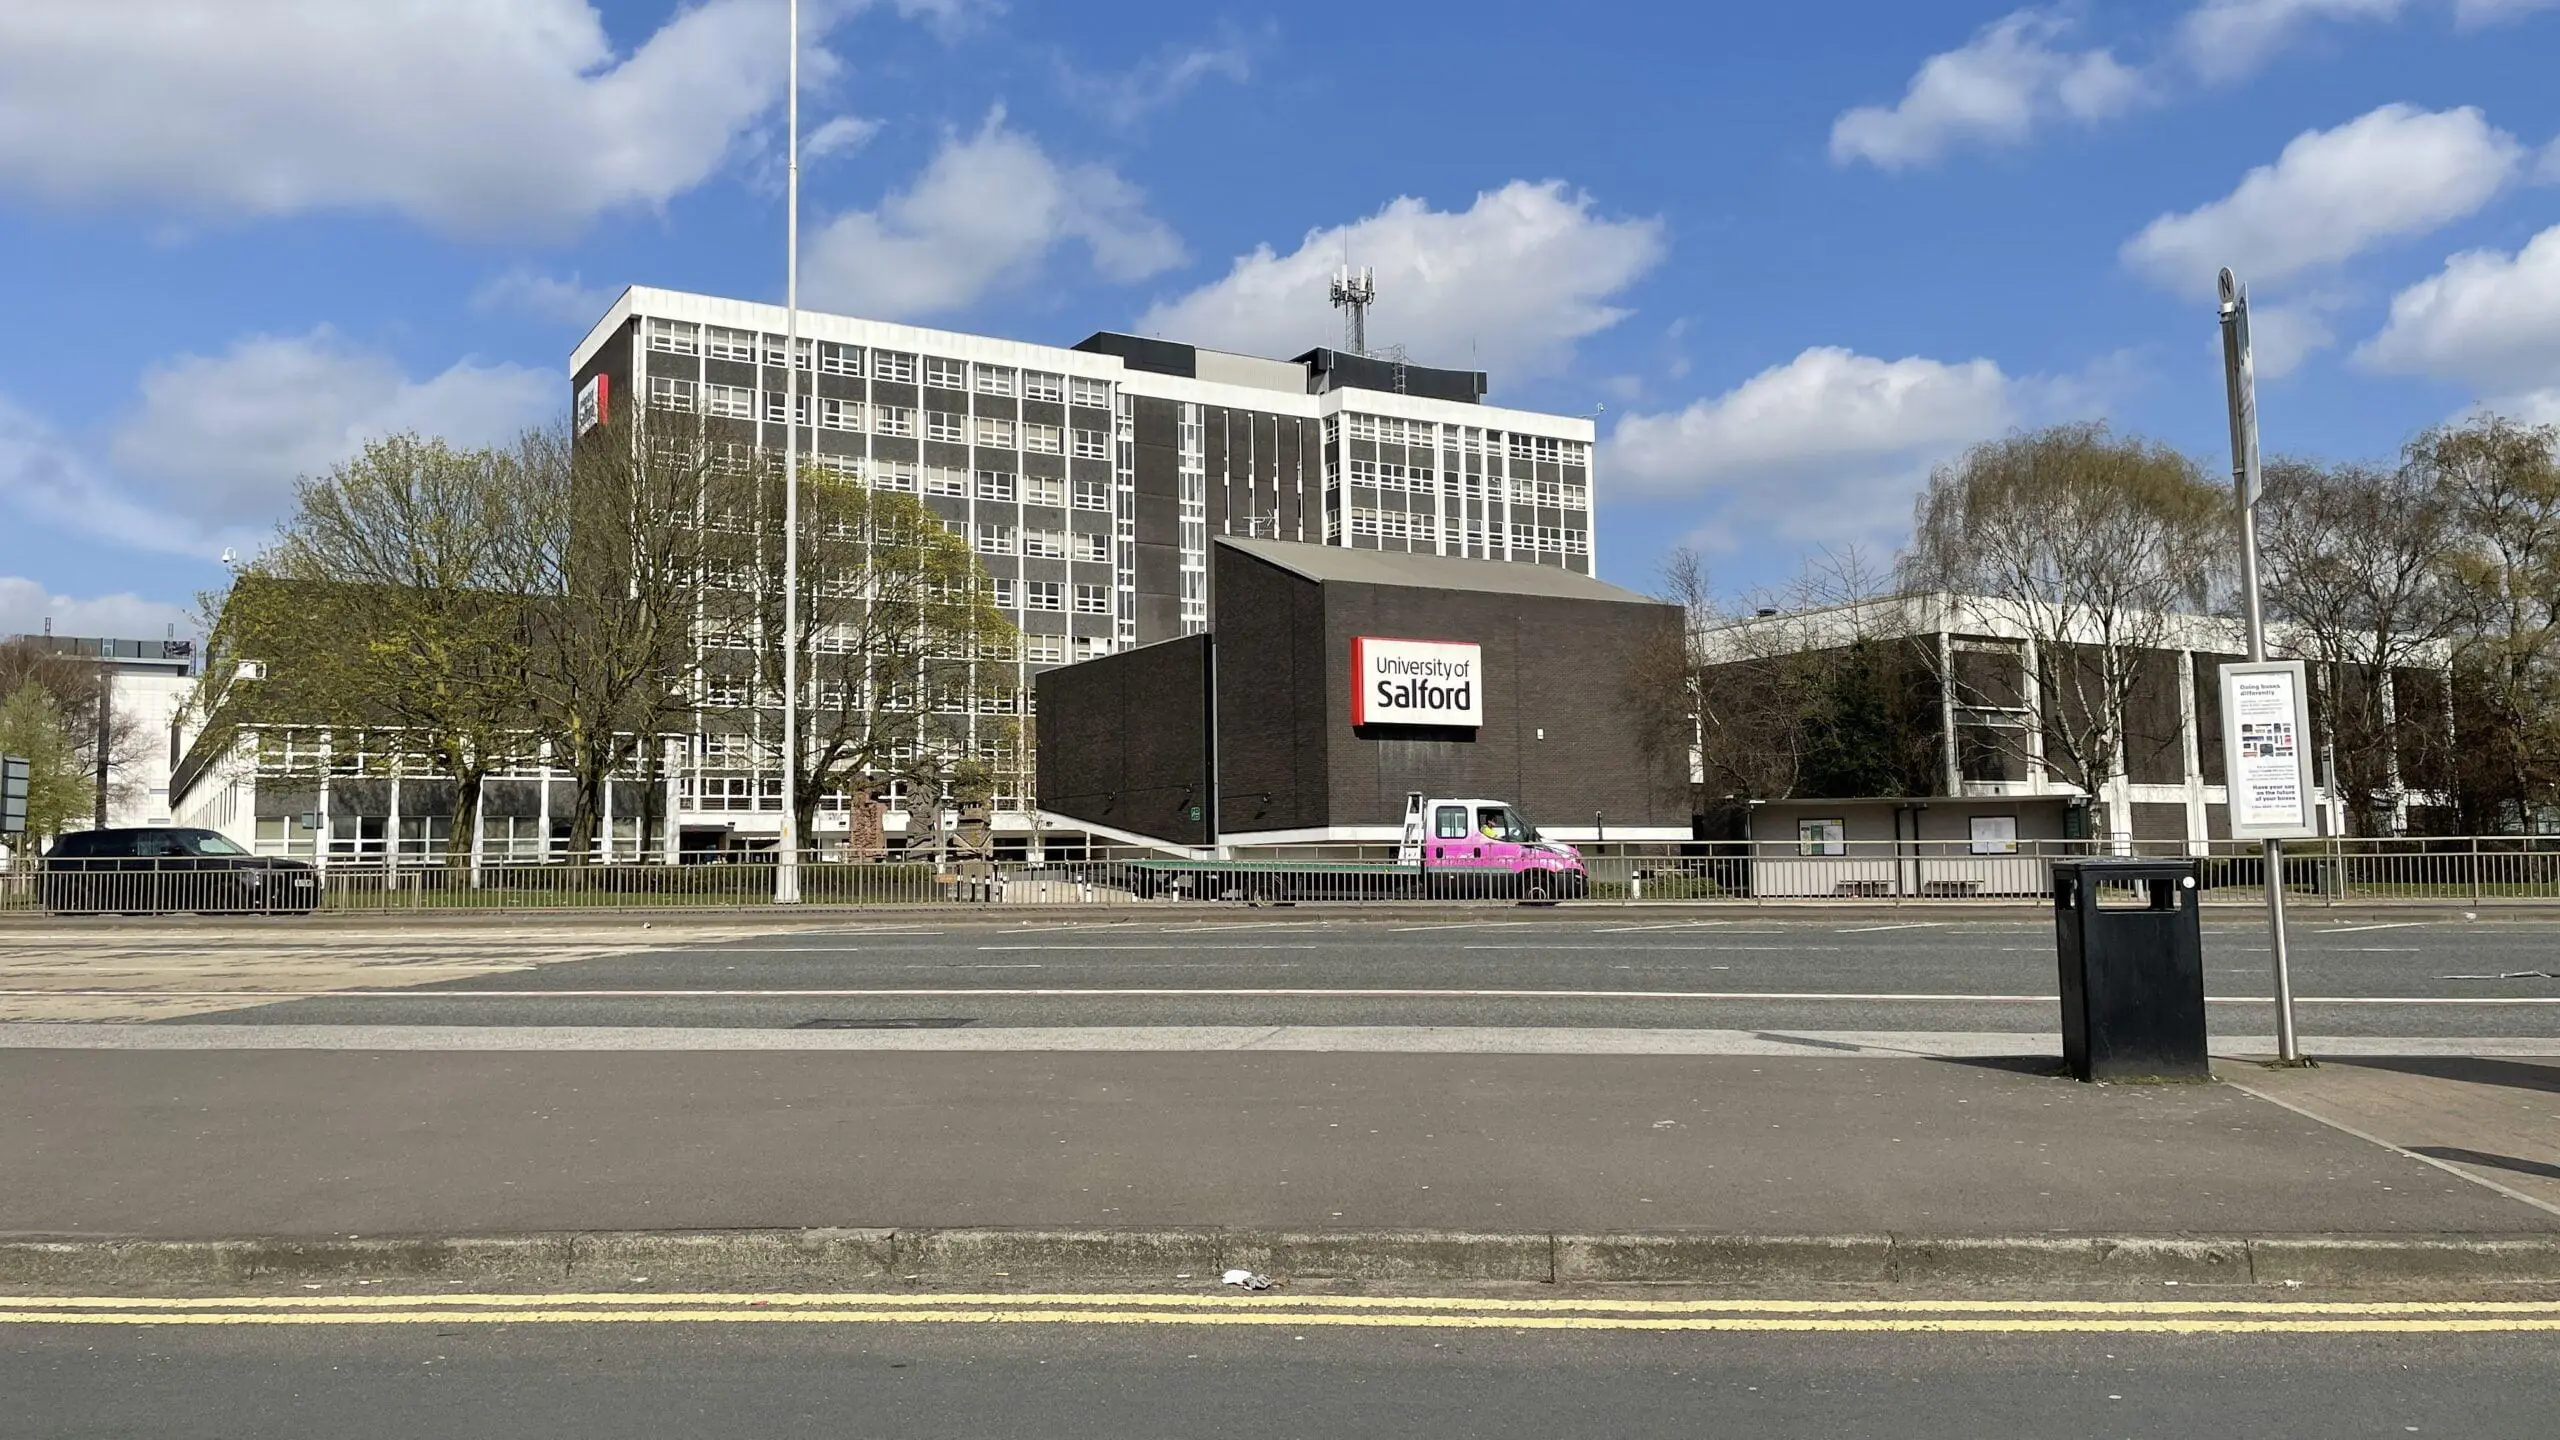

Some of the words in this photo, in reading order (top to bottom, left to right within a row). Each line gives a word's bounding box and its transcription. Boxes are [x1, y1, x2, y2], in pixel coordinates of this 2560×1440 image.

[2221, 273, 2231, 298] N
[1376, 656, 1452, 680] University
[1454, 660, 1470, 677] of
[1377, 678, 1471, 710] Salford
